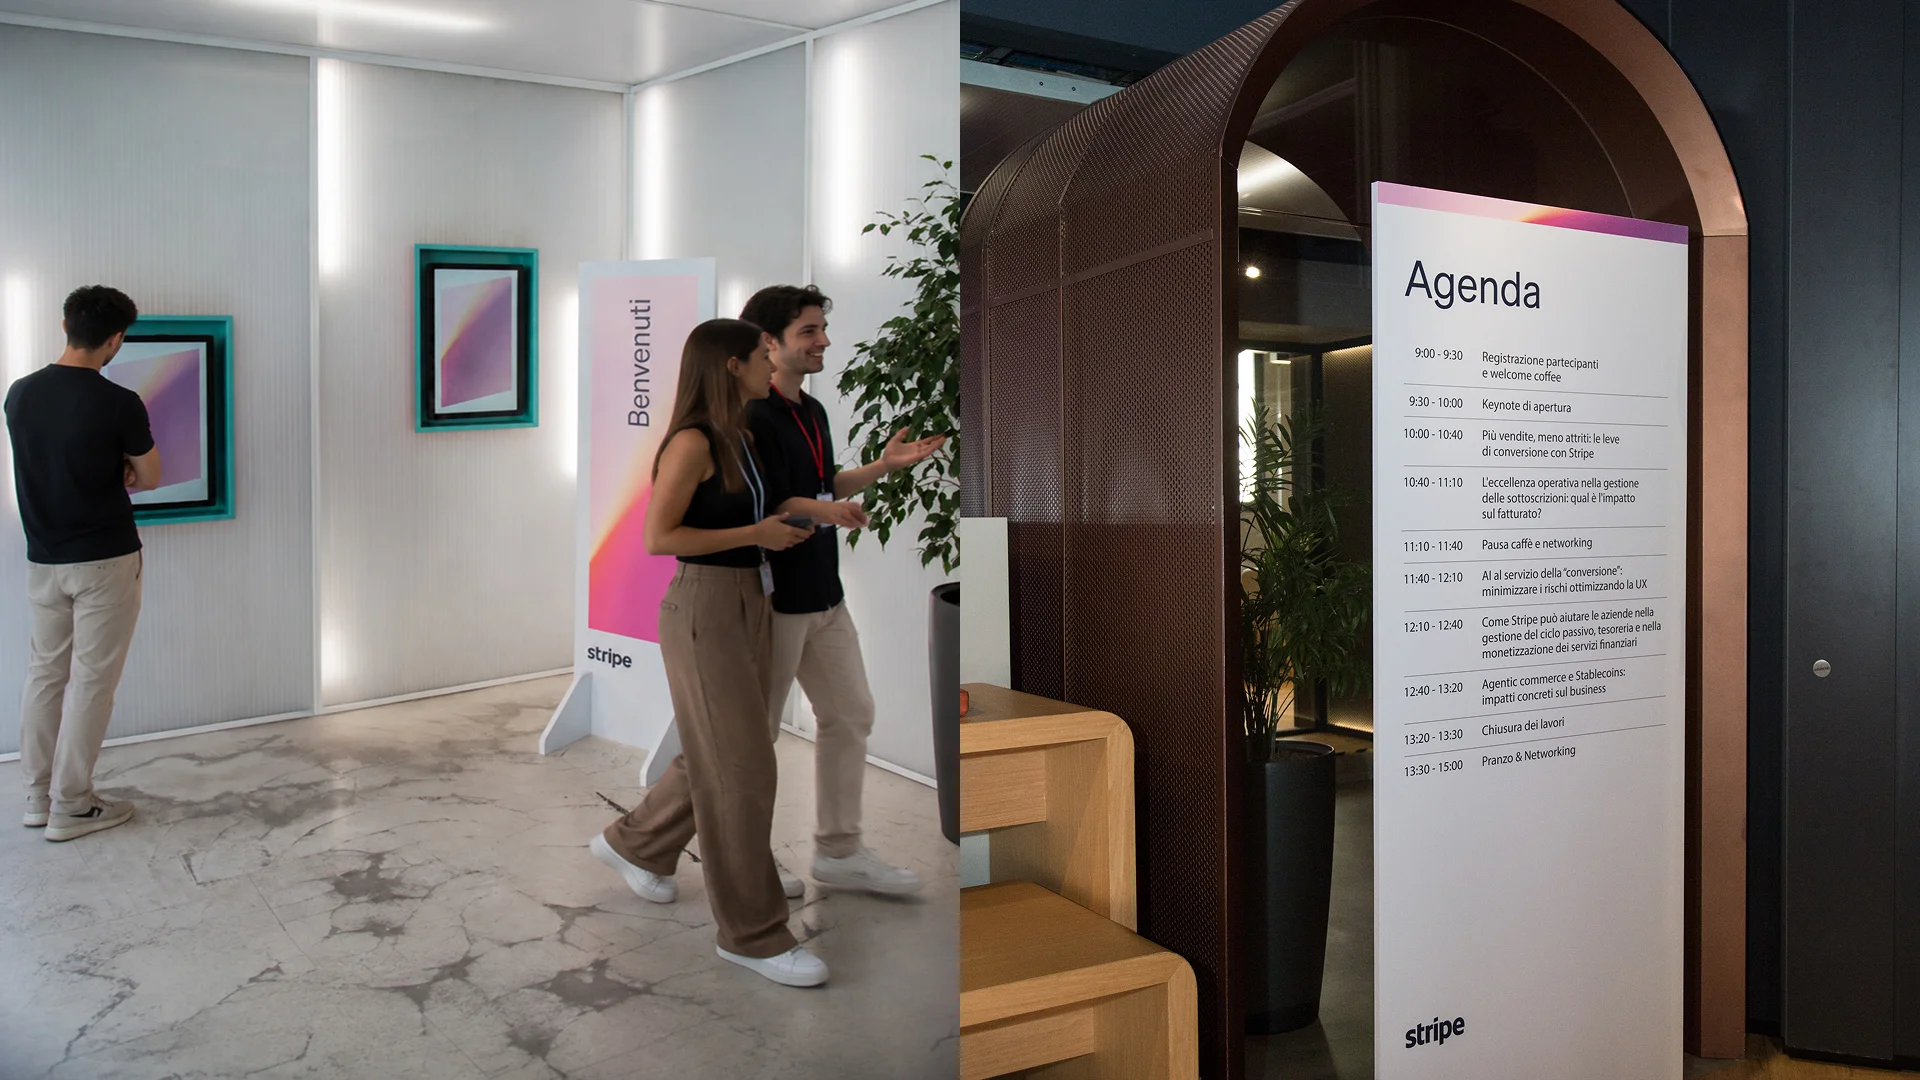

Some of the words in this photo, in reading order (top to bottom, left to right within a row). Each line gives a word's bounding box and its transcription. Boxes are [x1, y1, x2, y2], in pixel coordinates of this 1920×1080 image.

[1405, 260, 1540, 309] Agenda
[1414, 347, 1436, 359] 9:00
[1443, 349, 1463, 361] 9:30
[1482, 351, 1544, 366] Registrazione
[1546, 357, 1599, 371] partecipanti
[628, 299, 651, 427] Benvenuti
[1482, 369, 1488, 379] e
[1490, 368, 1532, 381] welcome
[1533, 370, 1562, 383] coffee
[1409, 395, 1430, 407] 9:30
[1438, 397, 1463, 409] 10:00
[1482, 398, 1521, 413] Keynote
[1522, 400, 1531, 411] di
[1533, 403, 1572, 414] apertura
[1404, 428, 1430, 439] 10:00
[1438, 429, 1463, 440] 10:40
[1482, 429, 1497, 441] Più
[1498, 430, 1536, 443] vendite,
[1537, 434, 1564, 443] meno
[1565, 433, 1592, 444] attriti:
[1593, 433, 1601, 444] le
[1602, 433, 1620, 444] leve
[1482, 445, 1491, 457] di
[1493, 447, 1549, 458] conversione
[1550, 449, 1567, 458] con
[1569, 447, 1595, 461] Stripe
[1404, 476, 1430, 488] 10:40
[1438, 477, 1463, 488] 11:10
[1537, 477, 1579, 490] operativa
[1581, 477, 1602, 488] nella
[1603, 478, 1639, 491] gestione
[1481, 492, 1505, 504] delle
[1507, 492, 1569, 504] sottoscrizioni:
[1570, 492, 1590, 505] qual
[1591, 492, 1597, 503] è
[1482, 508, 1495, 520] sul
[1497, 507, 1542, 519] fatturato?
[1404, 541, 1430, 552] 11:10
[1438, 540, 1463, 551] 11:40
[1482, 539, 1509, 550] Pausa
[1510, 537, 1533, 550] caffè
[1534, 540, 1541, 549] e
[1542, 537, 1593, 550] networking
[1404, 573, 1430, 585] 11:40
[1438, 572, 1463, 583] 12:10
[1481, 570, 1492, 581] AI
[1493, 569, 1502, 581] al
[1504, 568, 1539, 581] servizio
[1540, 567, 1562, 579] della
[1482, 585, 1538, 597] minimizzare
[1539, 583, 1542, 594] i
[1544, 582, 1568, 594] rischi
[1569, 580, 1625, 593] ottimizzando
[1626, 579, 1634, 590] la
[1635, 579, 1648, 589] UX
[1481, 616, 1510, 628] Come
[1511, 614, 1538, 627] Stripe
[1540, 612, 1558, 627] può
[1559, 612, 1590, 623] aiutare
[1591, 610, 1599, 621] le
[1600, 608, 1633, 620] aziende
[1635, 607, 1654, 618] nella
[1404, 621, 1430, 633] 12:10
[1438, 619, 1463, 630] 12:40
[1481, 631, 1522, 646] gestione
[1524, 628, 1538, 641] del
[1540, 627, 1561, 639] ciclo
[1562, 626, 1596, 640] passivo,
[1597, 623, 1634, 635] tesoreria
[1635, 624, 1641, 632] e
[1642, 621, 1661, 632] nella
[1482, 644, 1554, 659] monetizzazione
[1555, 642, 1569, 653] dei
[1571, 640, 1598, 652] servizi
[1599, 637, 1637, 649] finanziari
[587, 646, 633, 669] stripe
[1481, 676, 1518, 692] Agentic
[1519, 674, 1567, 686] commerce
[1568, 673, 1574, 682] e
[1575, 667, 1626, 681] Stablecoins:
[1405, 685, 1430, 697] 12:40
[1438, 682, 1463, 694] 13:20
[1482, 692, 1515, 707] impatti
[1517, 688, 1553, 702] concreti
[1555, 686, 1568, 698] sul
[1570, 684, 1607, 697] business
[1481, 723, 1522, 736] Chiusura
[1524, 719, 1539, 731] dei
[1540, 716, 1565, 729] lavori
[1405, 732, 1430, 745] 13:20
[1439, 728, 1463, 741] 13:30
[1482, 755, 1514, 767] Pranzo
[1515, 751, 1523, 762] &
[1524, 746, 1576, 761] Networking
[1405, 764, 1430, 777] 13:30
[1438, 759, 1463, 772] 15:00
[1405, 1016, 1465, 1049] stripe
